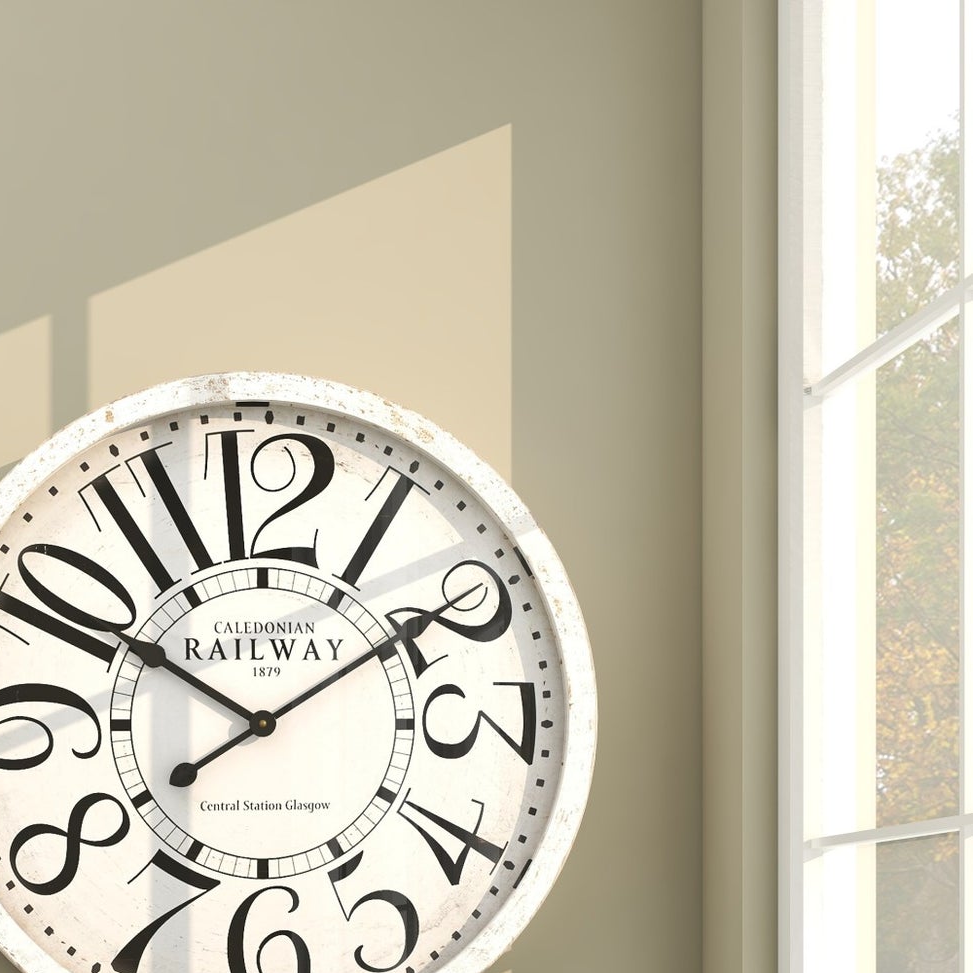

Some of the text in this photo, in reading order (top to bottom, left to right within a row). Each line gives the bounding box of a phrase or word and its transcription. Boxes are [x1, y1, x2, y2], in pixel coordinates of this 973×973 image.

[77, 441, 183, 600] 11
[204, 429, 336, 569] 12
[364, 465, 431, 592] 1
[184, 637, 344, 661] RAILWAY
[214, 621, 315, 634] CALEDONIAN
[384, 559, 513, 679] 2
[252, 666, 281, 677] 1879
[422, 681, 536, 766] 3
[9, 792, 130, 896] 8
[200, 799, 331, 813] Central Station Glasgow
[397, 787, 509, 886] 4
[327, 850, 420, 973] 5
